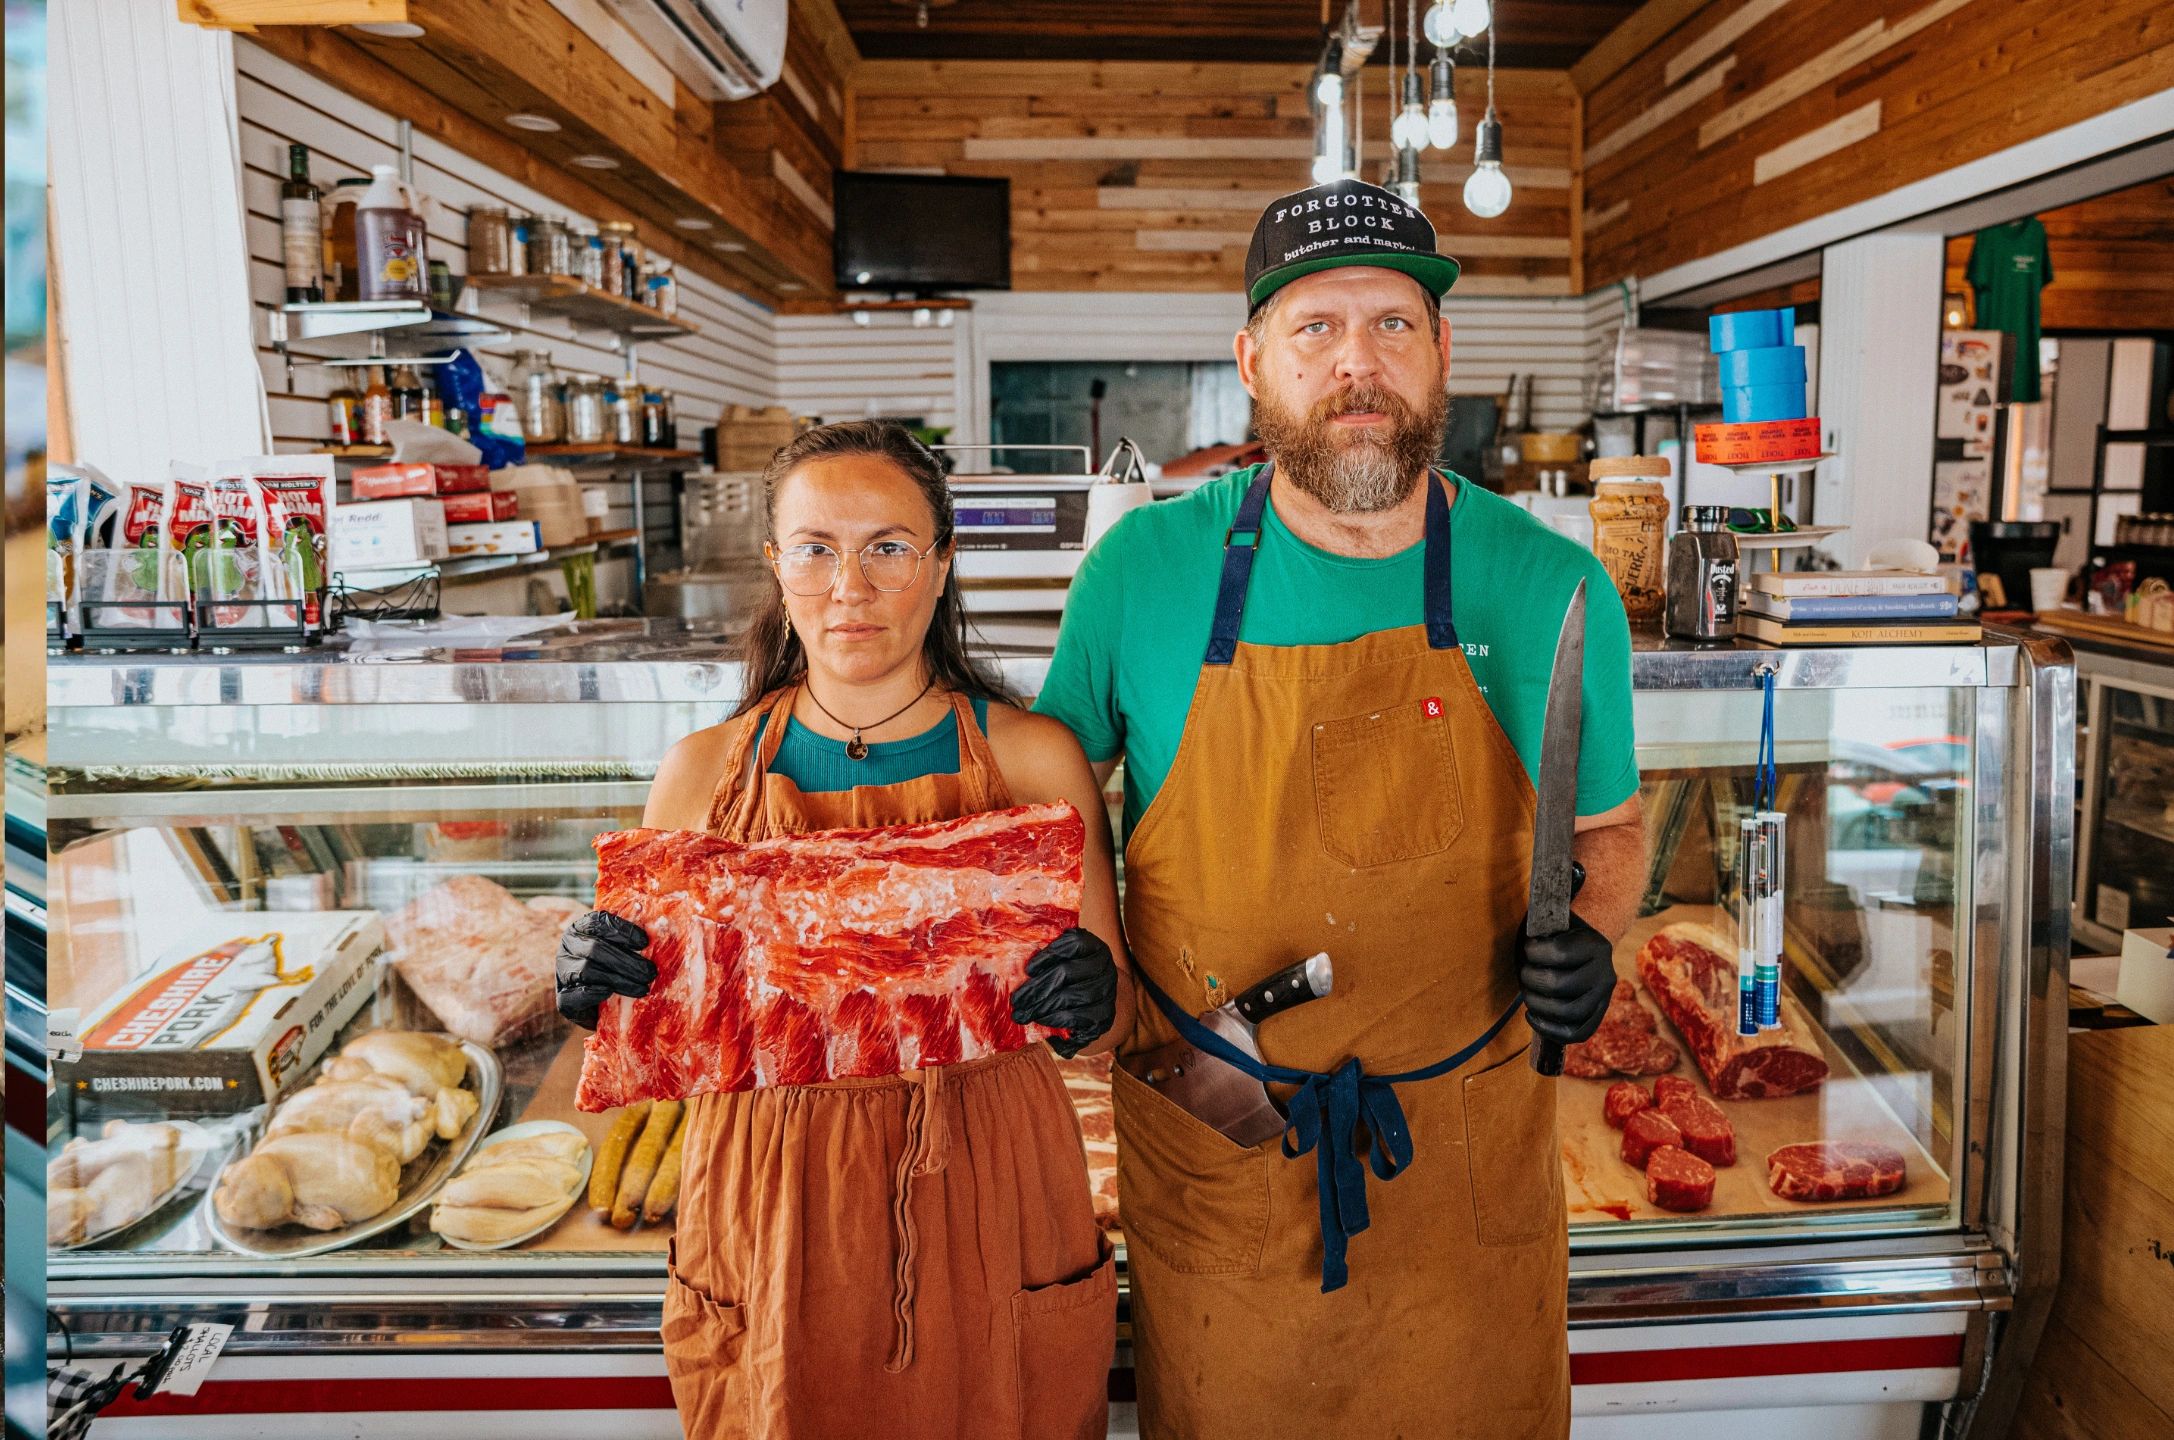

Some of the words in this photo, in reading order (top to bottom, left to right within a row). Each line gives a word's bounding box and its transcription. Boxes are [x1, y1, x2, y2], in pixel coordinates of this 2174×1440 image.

[1275, 194, 1416, 223] FORGOTTEN
[1307, 215, 1395, 234] BLOCK
[1284, 237, 1339, 262] butcher
[1343, 235, 1371, 245] and
[213, 491, 247, 505] HOT
[276, 490, 309, 502] HOT
[1876, 629, 1923, 639] ALCHEMY
[1427, 701, 1440, 716] &
[105, 955, 233, 1048] CHESHIRE
[309, 1010, 325, 1033] FOR
[323, 995, 339, 1016] THE
[339, 975, 357, 1000] LOVE
[356, 963, 366, 979] OF
[365, 943, 384, 966] PORK
[151, 992, 234, 1046] PORK
[92, 1076, 225, 1092] CHESHIREPORK.COM
[179, 1326, 211, 1372] SHALLOTS
[198, 1332, 225, 1363] LOCAL
